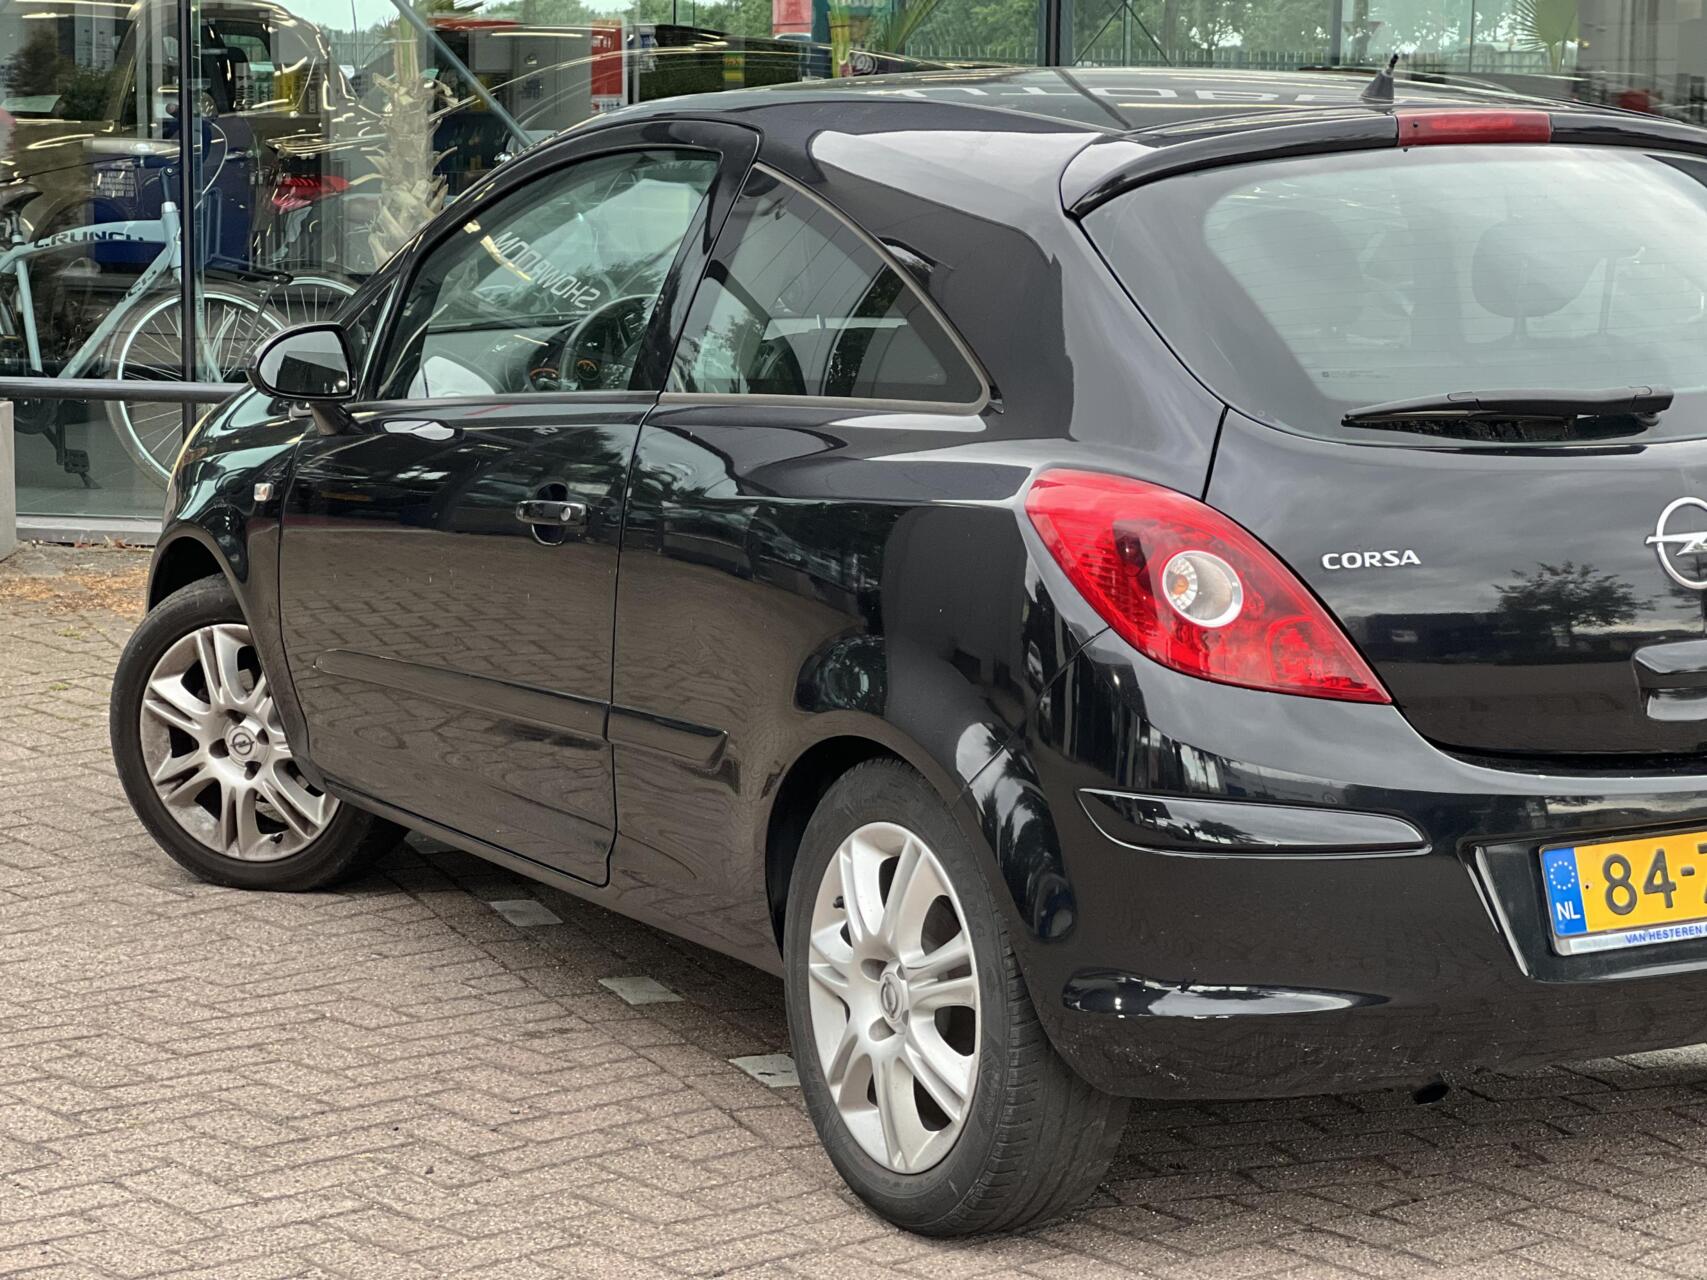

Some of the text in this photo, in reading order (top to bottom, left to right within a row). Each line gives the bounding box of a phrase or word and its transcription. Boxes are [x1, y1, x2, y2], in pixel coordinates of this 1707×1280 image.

[1321, 549, 1422, 570] CORSA
[1555, 901, 1581, 921] NL
[1625, 932, 1646, 944] VAN
[1649, 927, 1703, 941] HESTEREN
